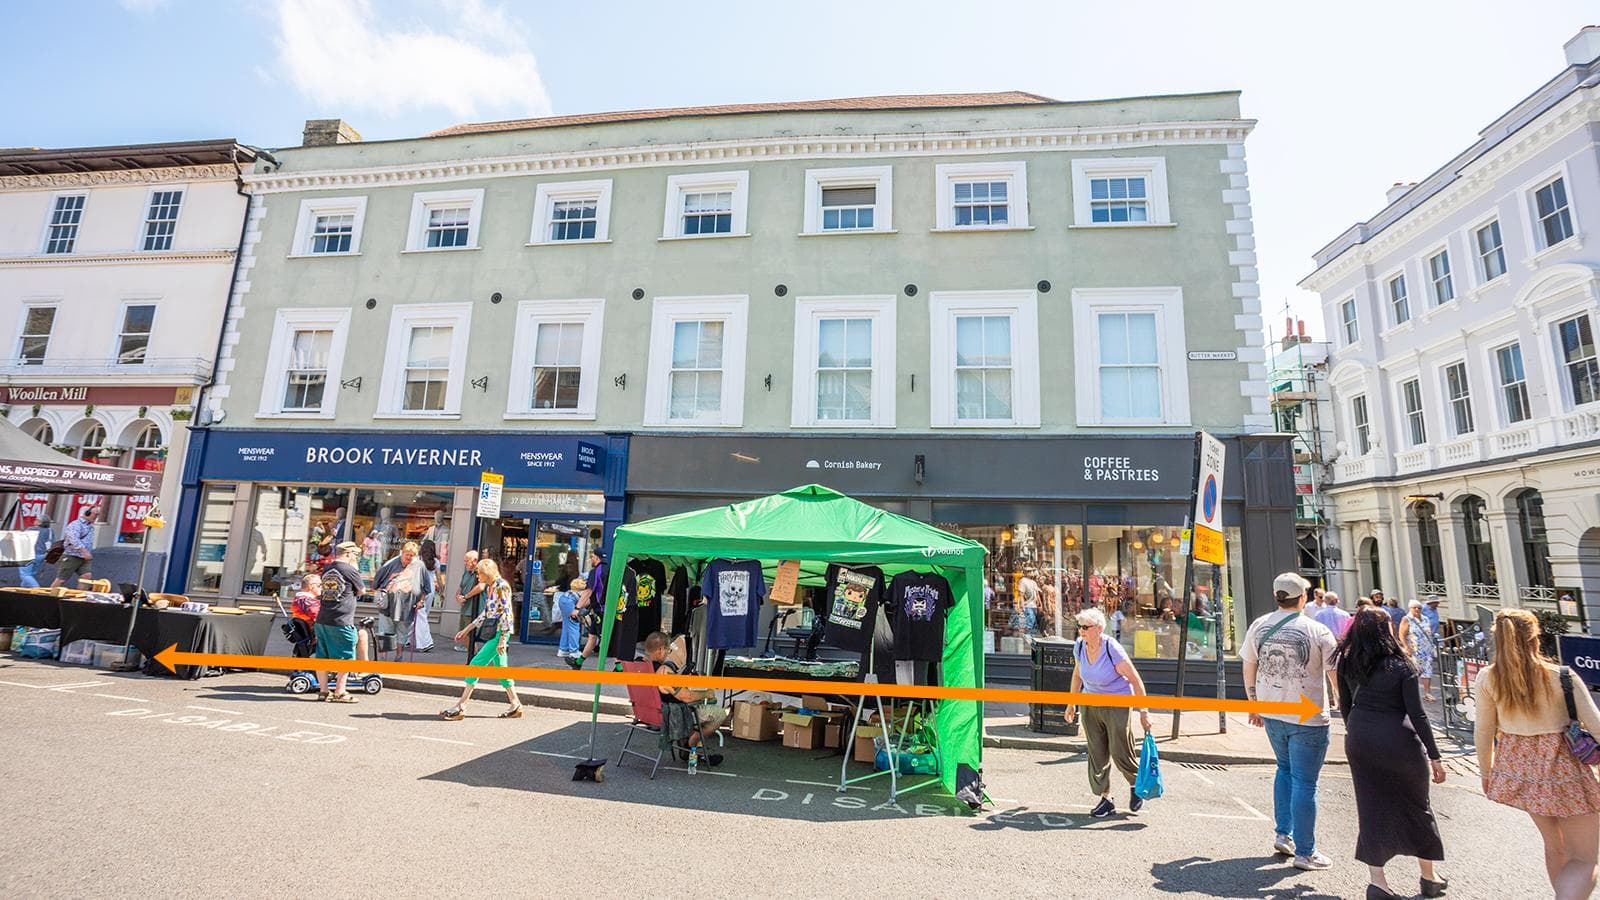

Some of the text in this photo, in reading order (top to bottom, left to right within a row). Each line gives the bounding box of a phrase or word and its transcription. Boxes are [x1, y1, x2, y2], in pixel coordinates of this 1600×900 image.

[8, 387, 88, 400] Woollen Mill
[238, 447, 275, 455] MENSWEAR
[306, 447, 482, 466] BROOK TAVERNER
[520, 452, 563, 460] MENSWEAR
[581, 446, 594, 455] BROOK
[578, 454, 596, 464] TAVERNER
[1084, 456, 1131, 469] COFFEE
[824, 460, 881, 471] Cornish Bakery
[15, 466, 60, 478] INSPIRED
[62, 470, 77, 479] BY
[79, 472, 115, 482] NATURE
[1084, 469, 1159, 481] & PASTRIES
[106, 708, 348, 744] DISABLED
